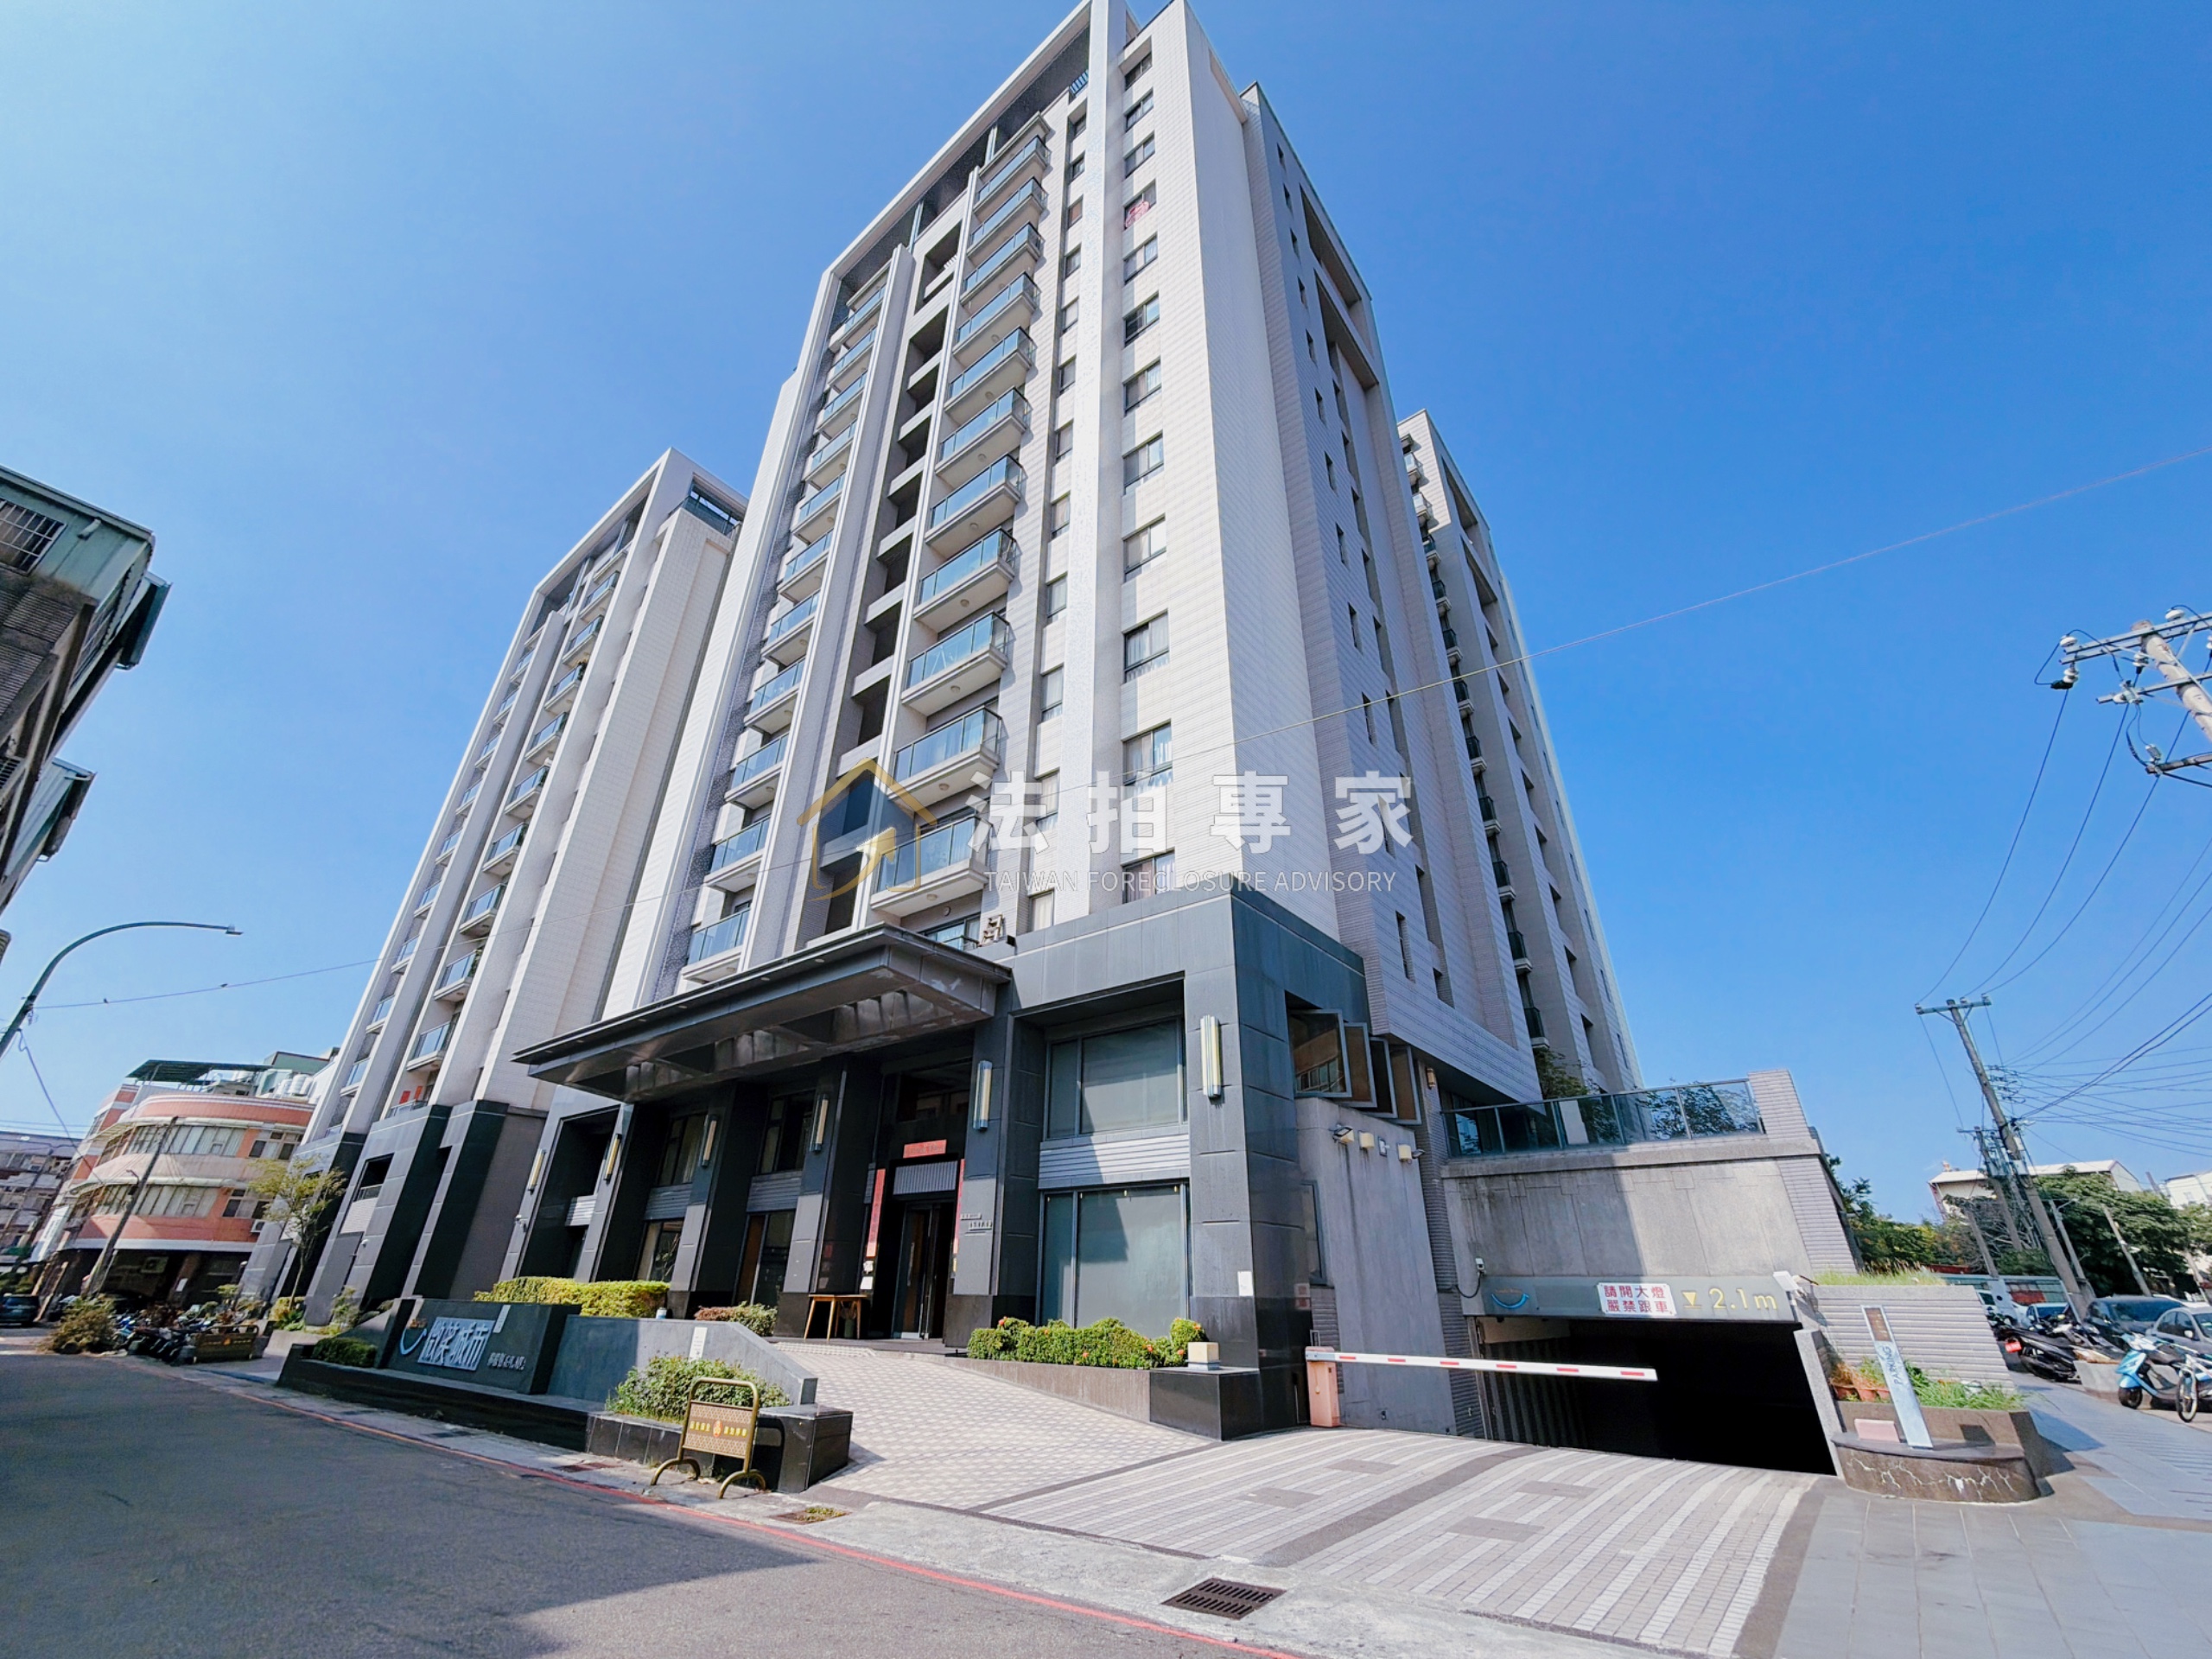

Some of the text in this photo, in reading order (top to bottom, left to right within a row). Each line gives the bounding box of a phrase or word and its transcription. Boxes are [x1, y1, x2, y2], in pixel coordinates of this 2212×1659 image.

[1604, 1286, 1666, 1299] 請開大燈
[1708, 1287, 1778, 1310] 2.1m
[1607, 1300, 1669, 1313] 嚴禁跟車
[1883, 1345, 1902, 1385] PARKING
